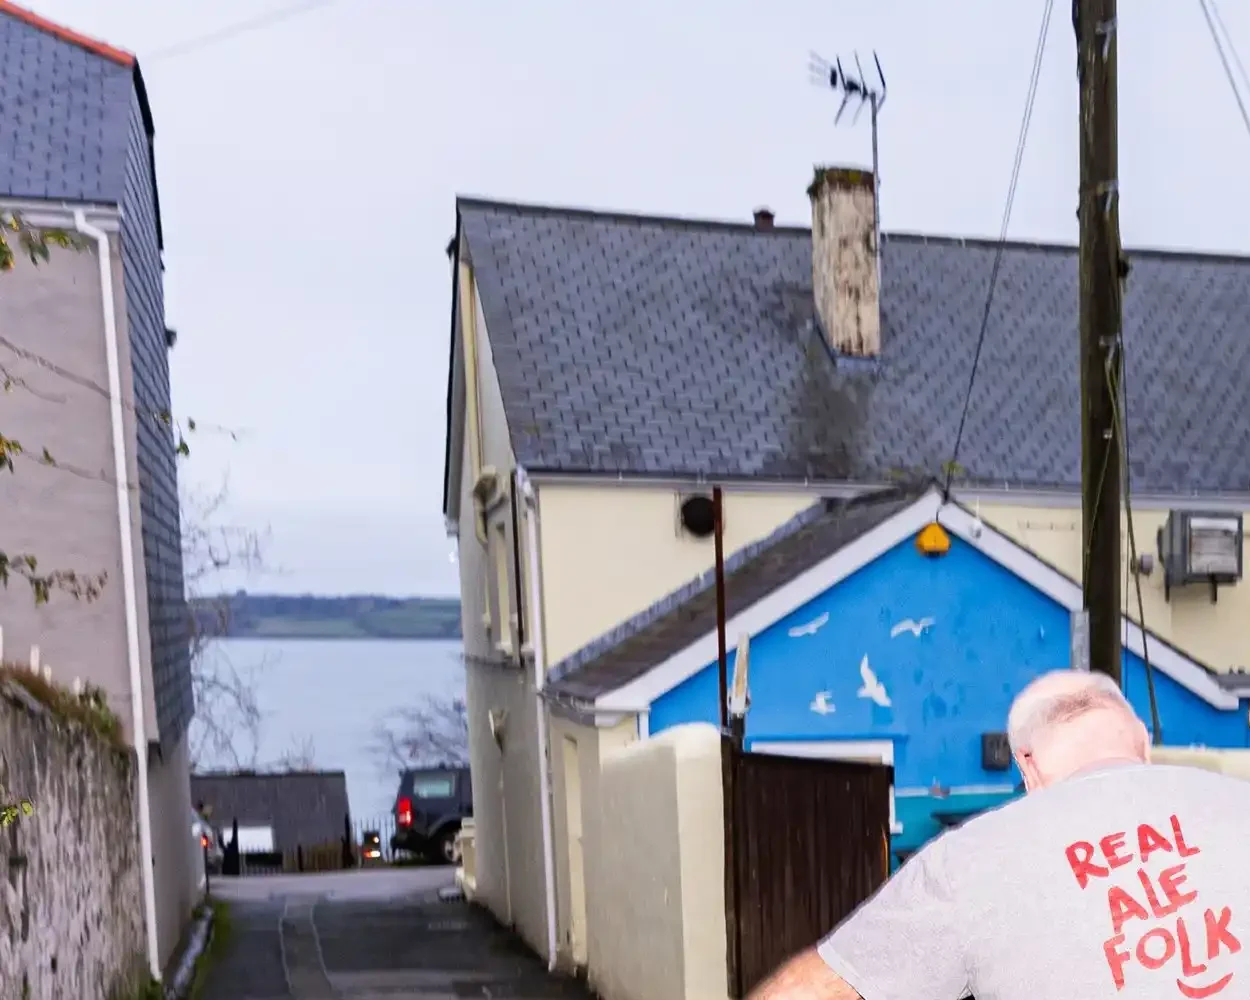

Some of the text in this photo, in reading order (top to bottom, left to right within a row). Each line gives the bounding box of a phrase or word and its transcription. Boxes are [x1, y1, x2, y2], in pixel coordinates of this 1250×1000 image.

[1065, 814, 1200, 889] REAL
[1107, 863, 1198, 934] ALE
[1103, 906, 1242, 992] FOLK
